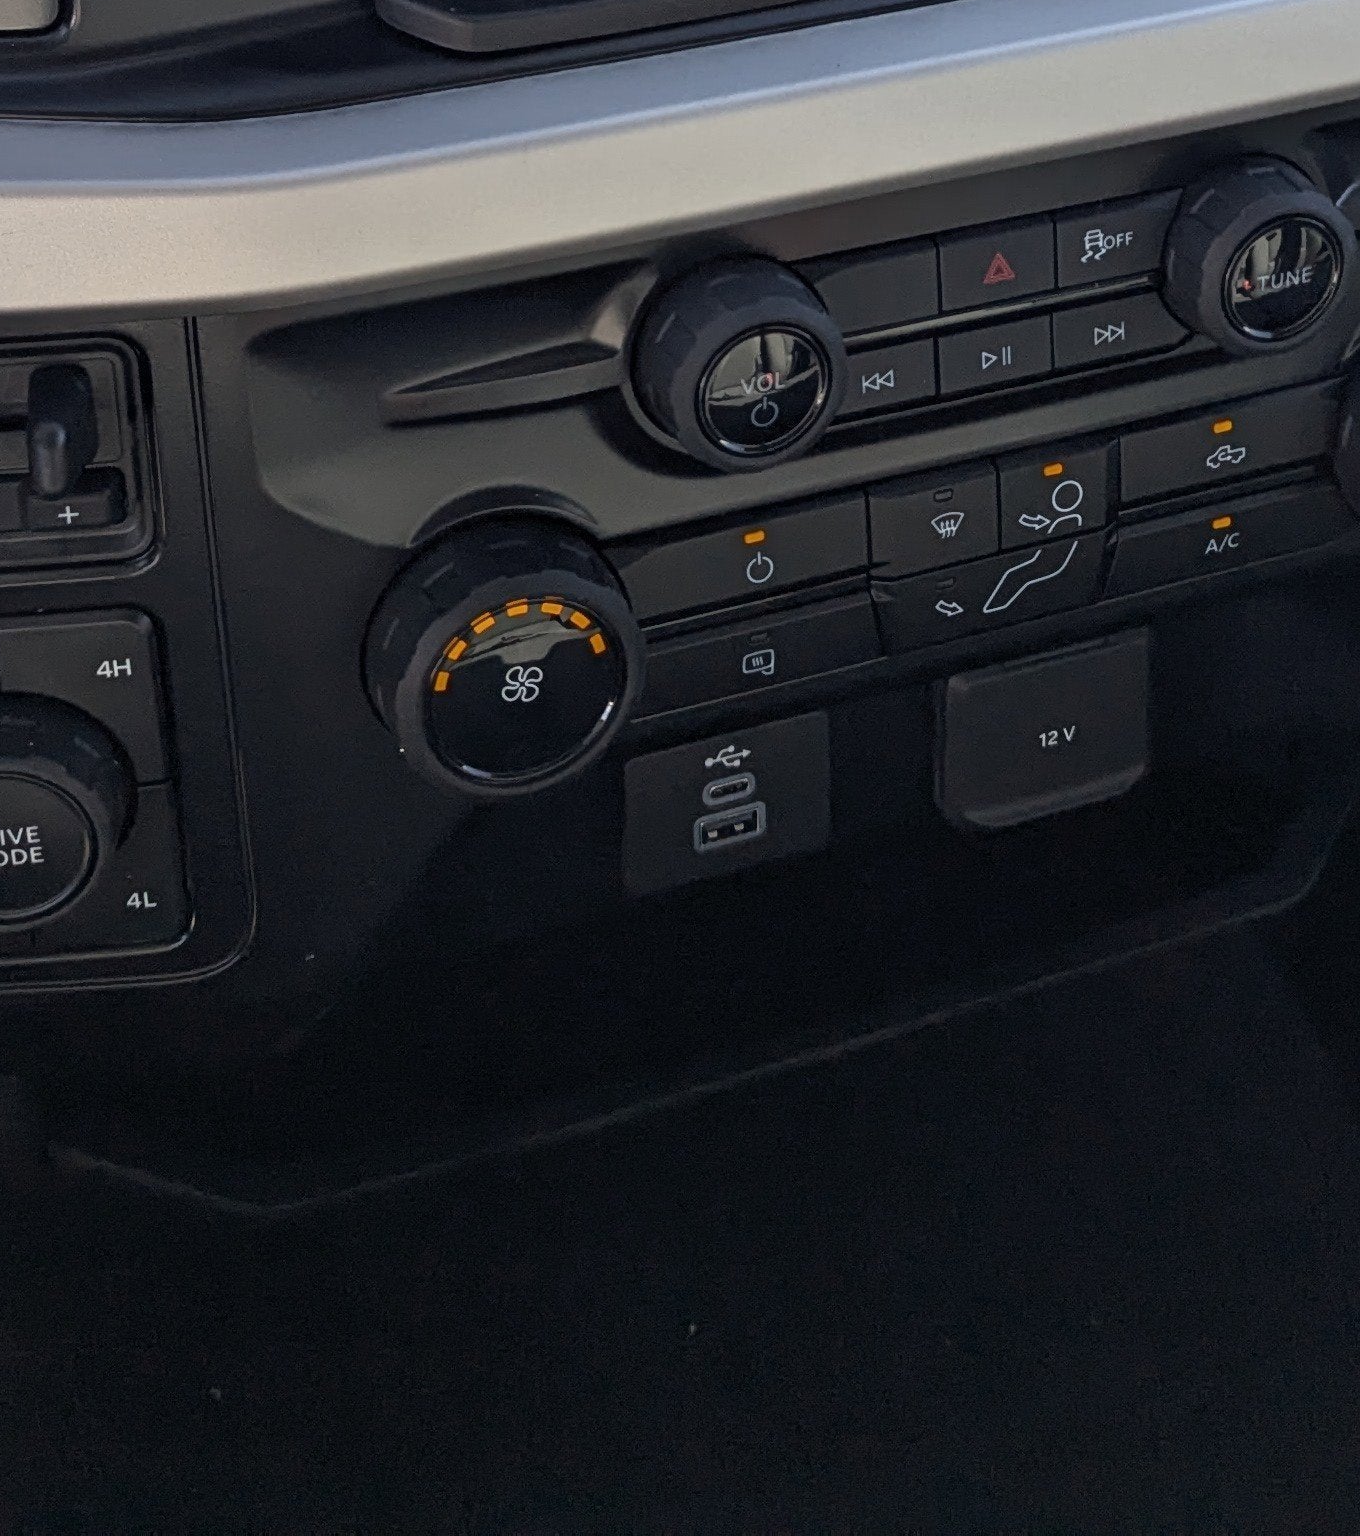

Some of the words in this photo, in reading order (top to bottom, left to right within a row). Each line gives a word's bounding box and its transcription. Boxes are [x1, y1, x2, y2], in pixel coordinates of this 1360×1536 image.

[1103, 230, 1134, 250] OFF
[1257, 265, 1316, 293] TUNE
[741, 371, 786, 395] VOL
[1204, 532, 1240, 555] A/C
[96, 657, 132, 679] 4H
[1039, 730, 1059, 748] 12
[1062, 725, 1076, 742] V
[126, 891, 158, 909] 4L
